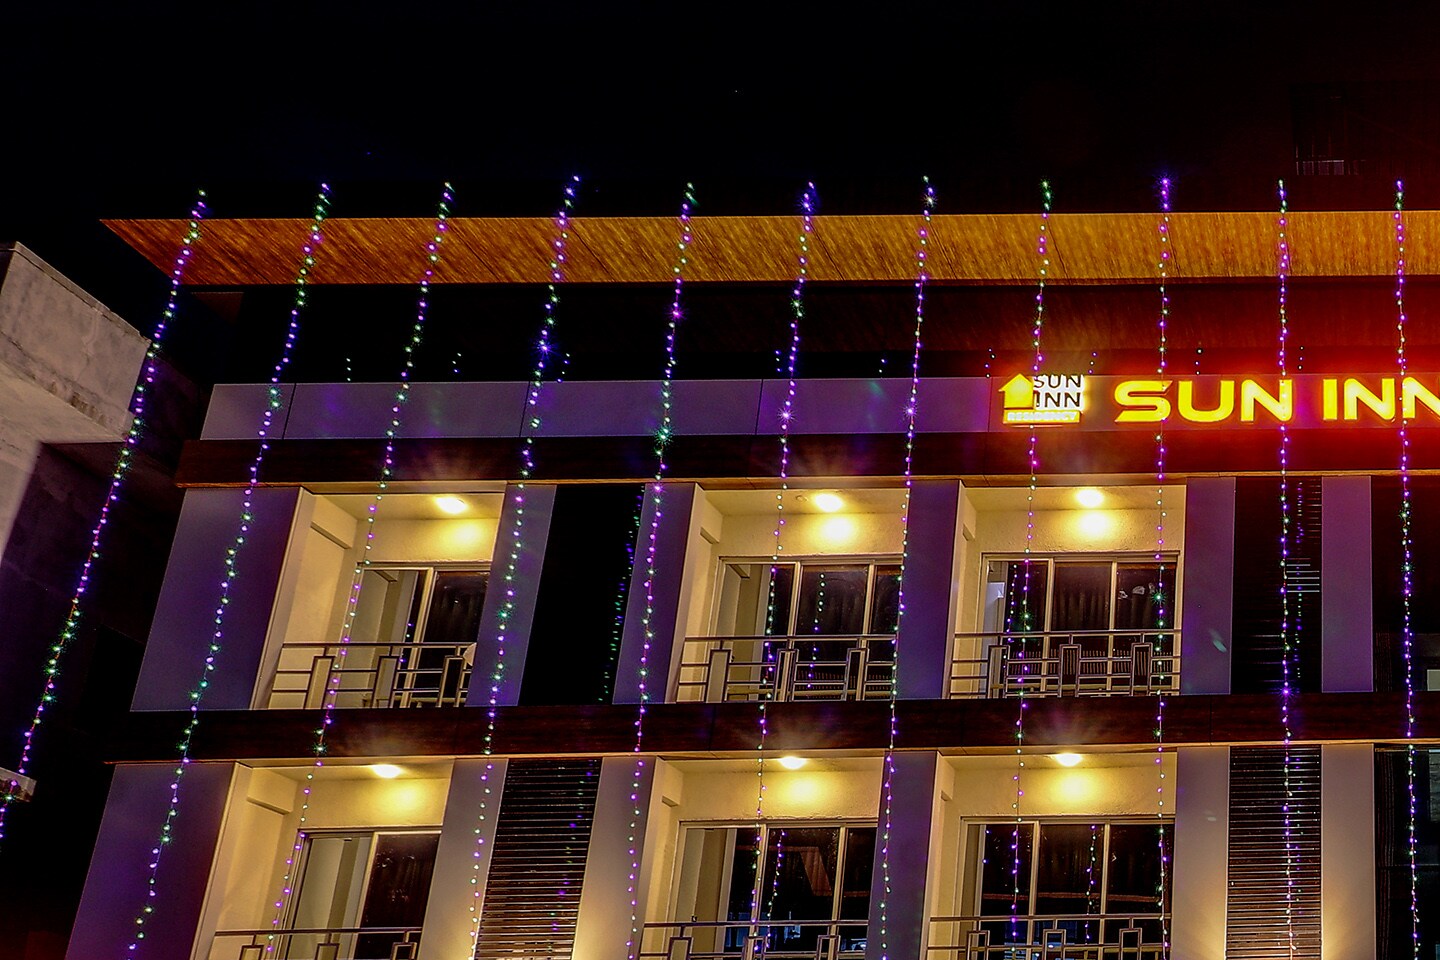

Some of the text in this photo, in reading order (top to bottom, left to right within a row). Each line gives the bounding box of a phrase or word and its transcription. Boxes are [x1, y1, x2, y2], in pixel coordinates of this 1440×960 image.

[1033, 373, 1081, 389] SUN
[1036, 391, 1081, 408] INN
[1114, 378, 1293, 423] SUN
